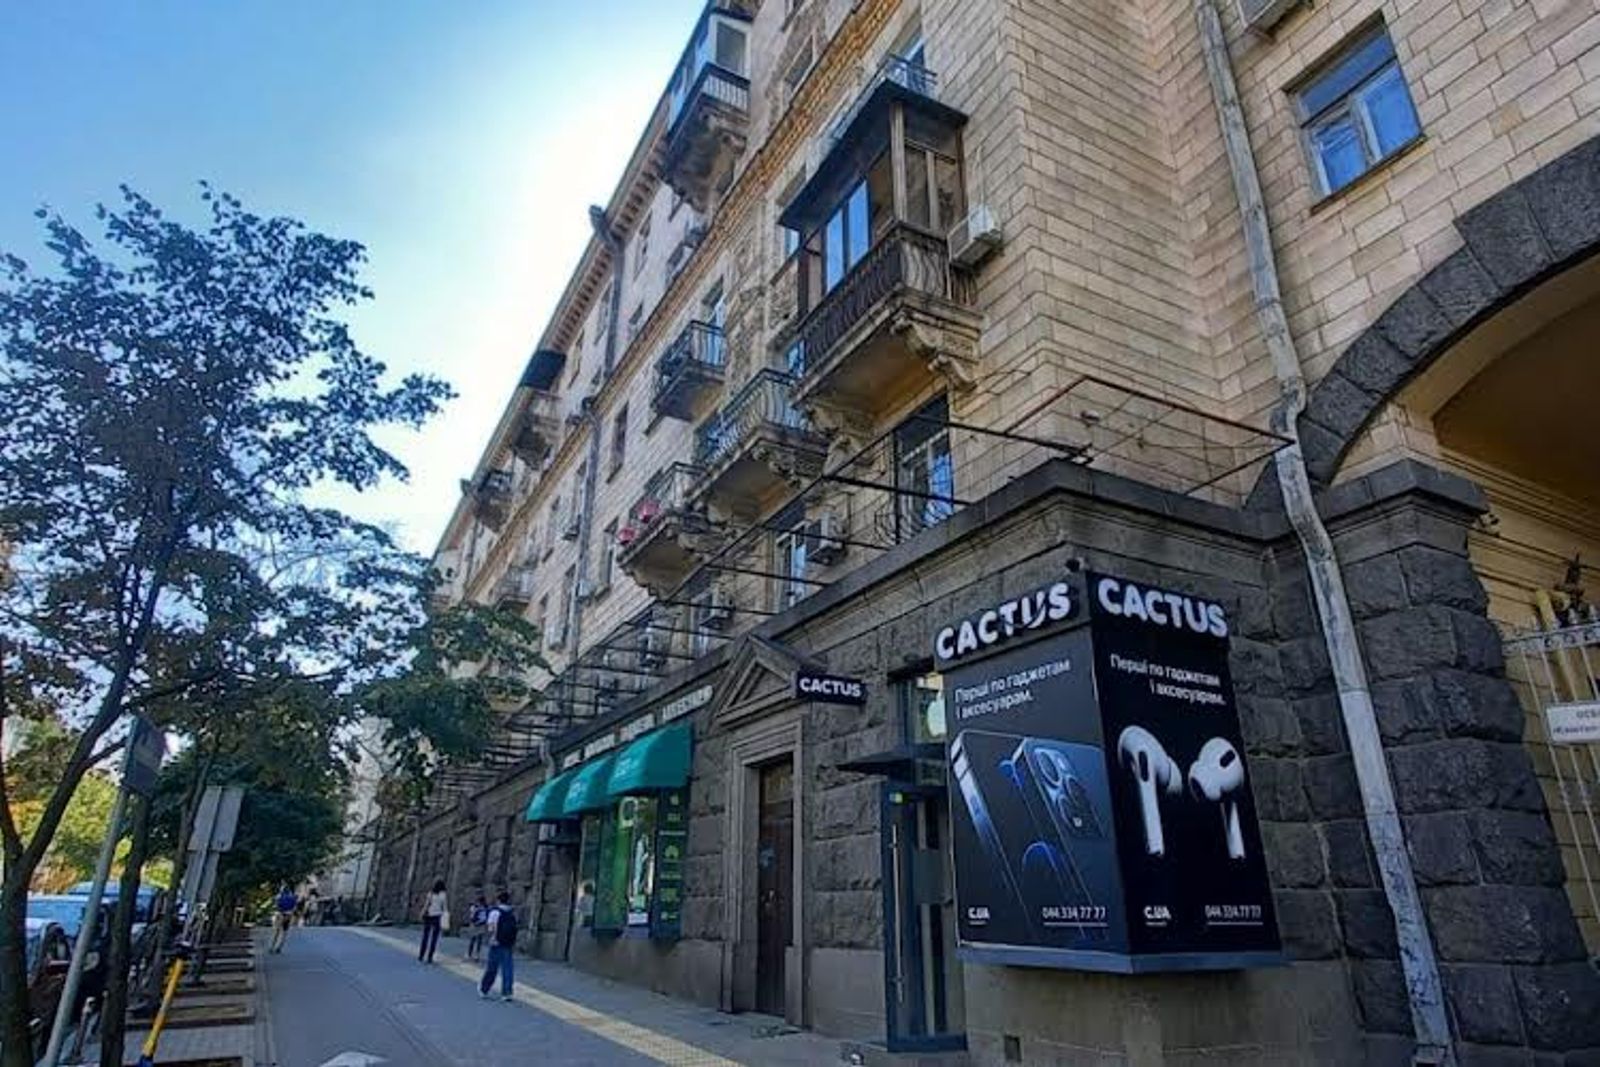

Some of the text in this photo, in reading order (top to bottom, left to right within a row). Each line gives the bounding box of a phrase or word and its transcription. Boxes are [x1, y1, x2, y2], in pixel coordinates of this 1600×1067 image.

[936, 582, 1071, 659] CACTUS
[1098, 578, 1228, 638] CACTUS
[799, 677, 862, 698] CACTUS
[990, 678, 1006, 694] по
